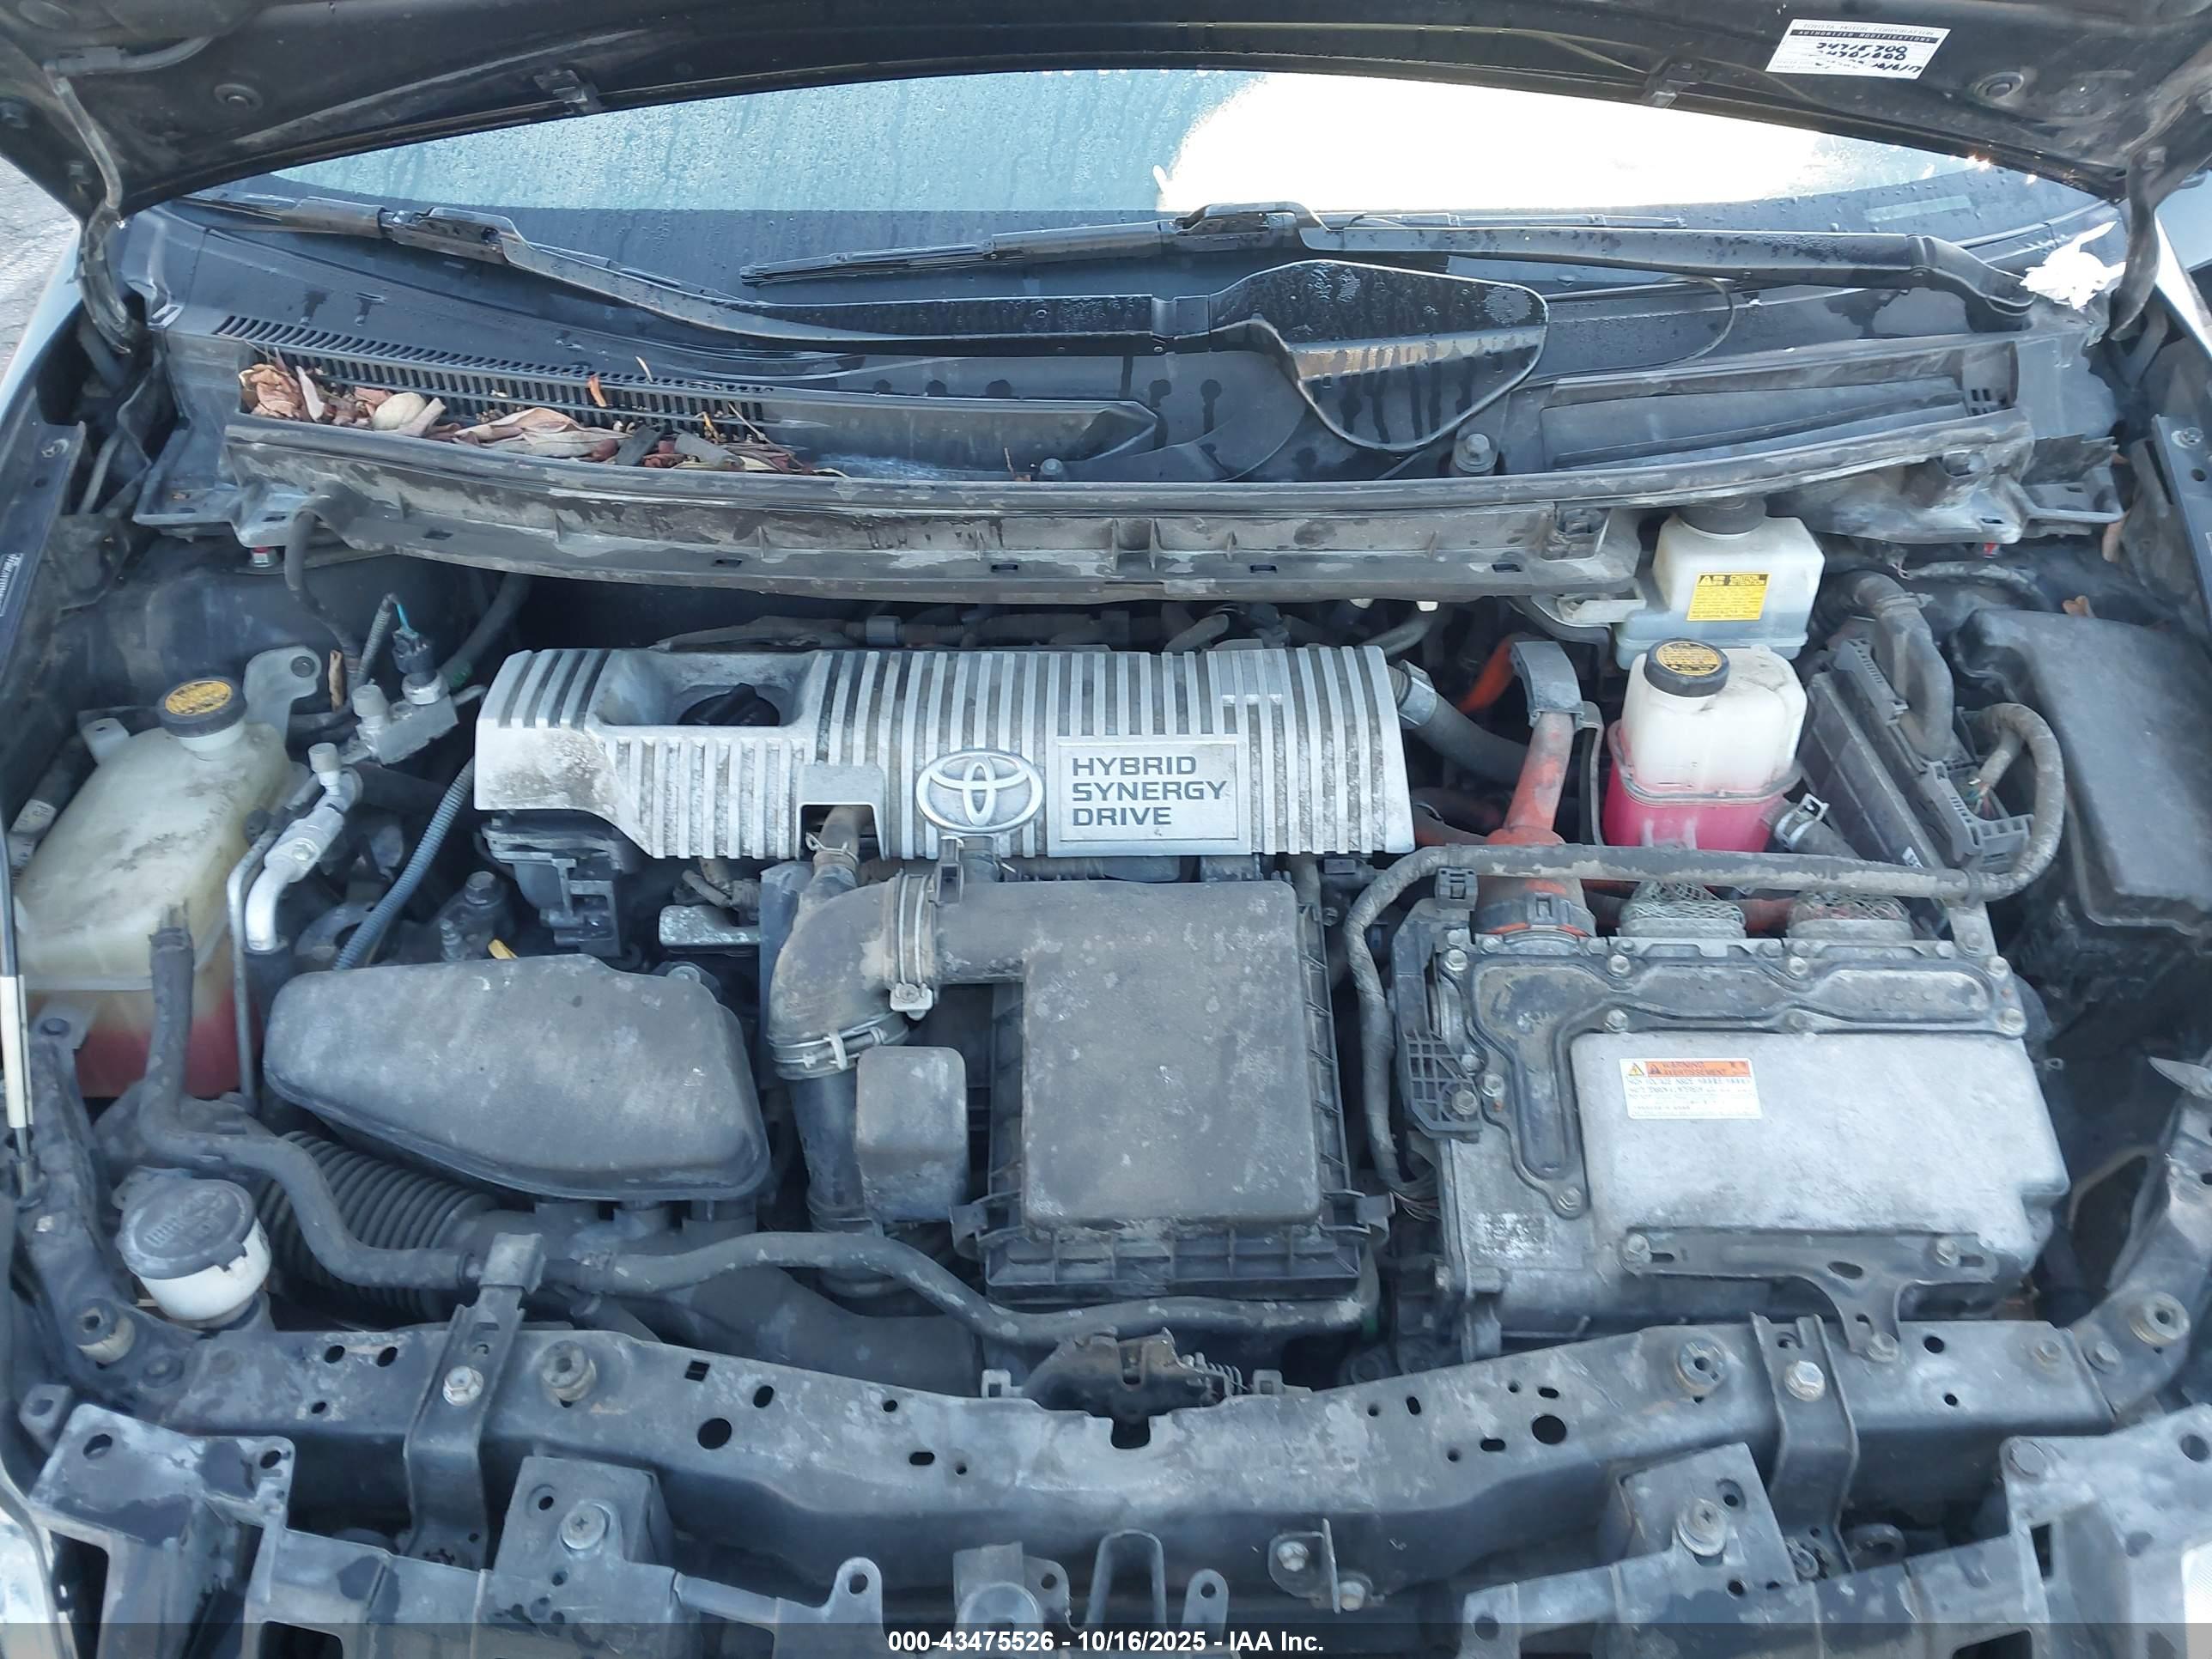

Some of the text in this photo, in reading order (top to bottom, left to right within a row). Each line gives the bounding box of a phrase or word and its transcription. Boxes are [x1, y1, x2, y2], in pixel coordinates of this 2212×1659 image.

[1858, 33, 1930, 42] MODIFICATIONS
[1073, 756, 1196, 776] HYBRID
[1072, 781, 1227, 802] SYNERGY
[1073, 807, 1171, 826] DRIVE
